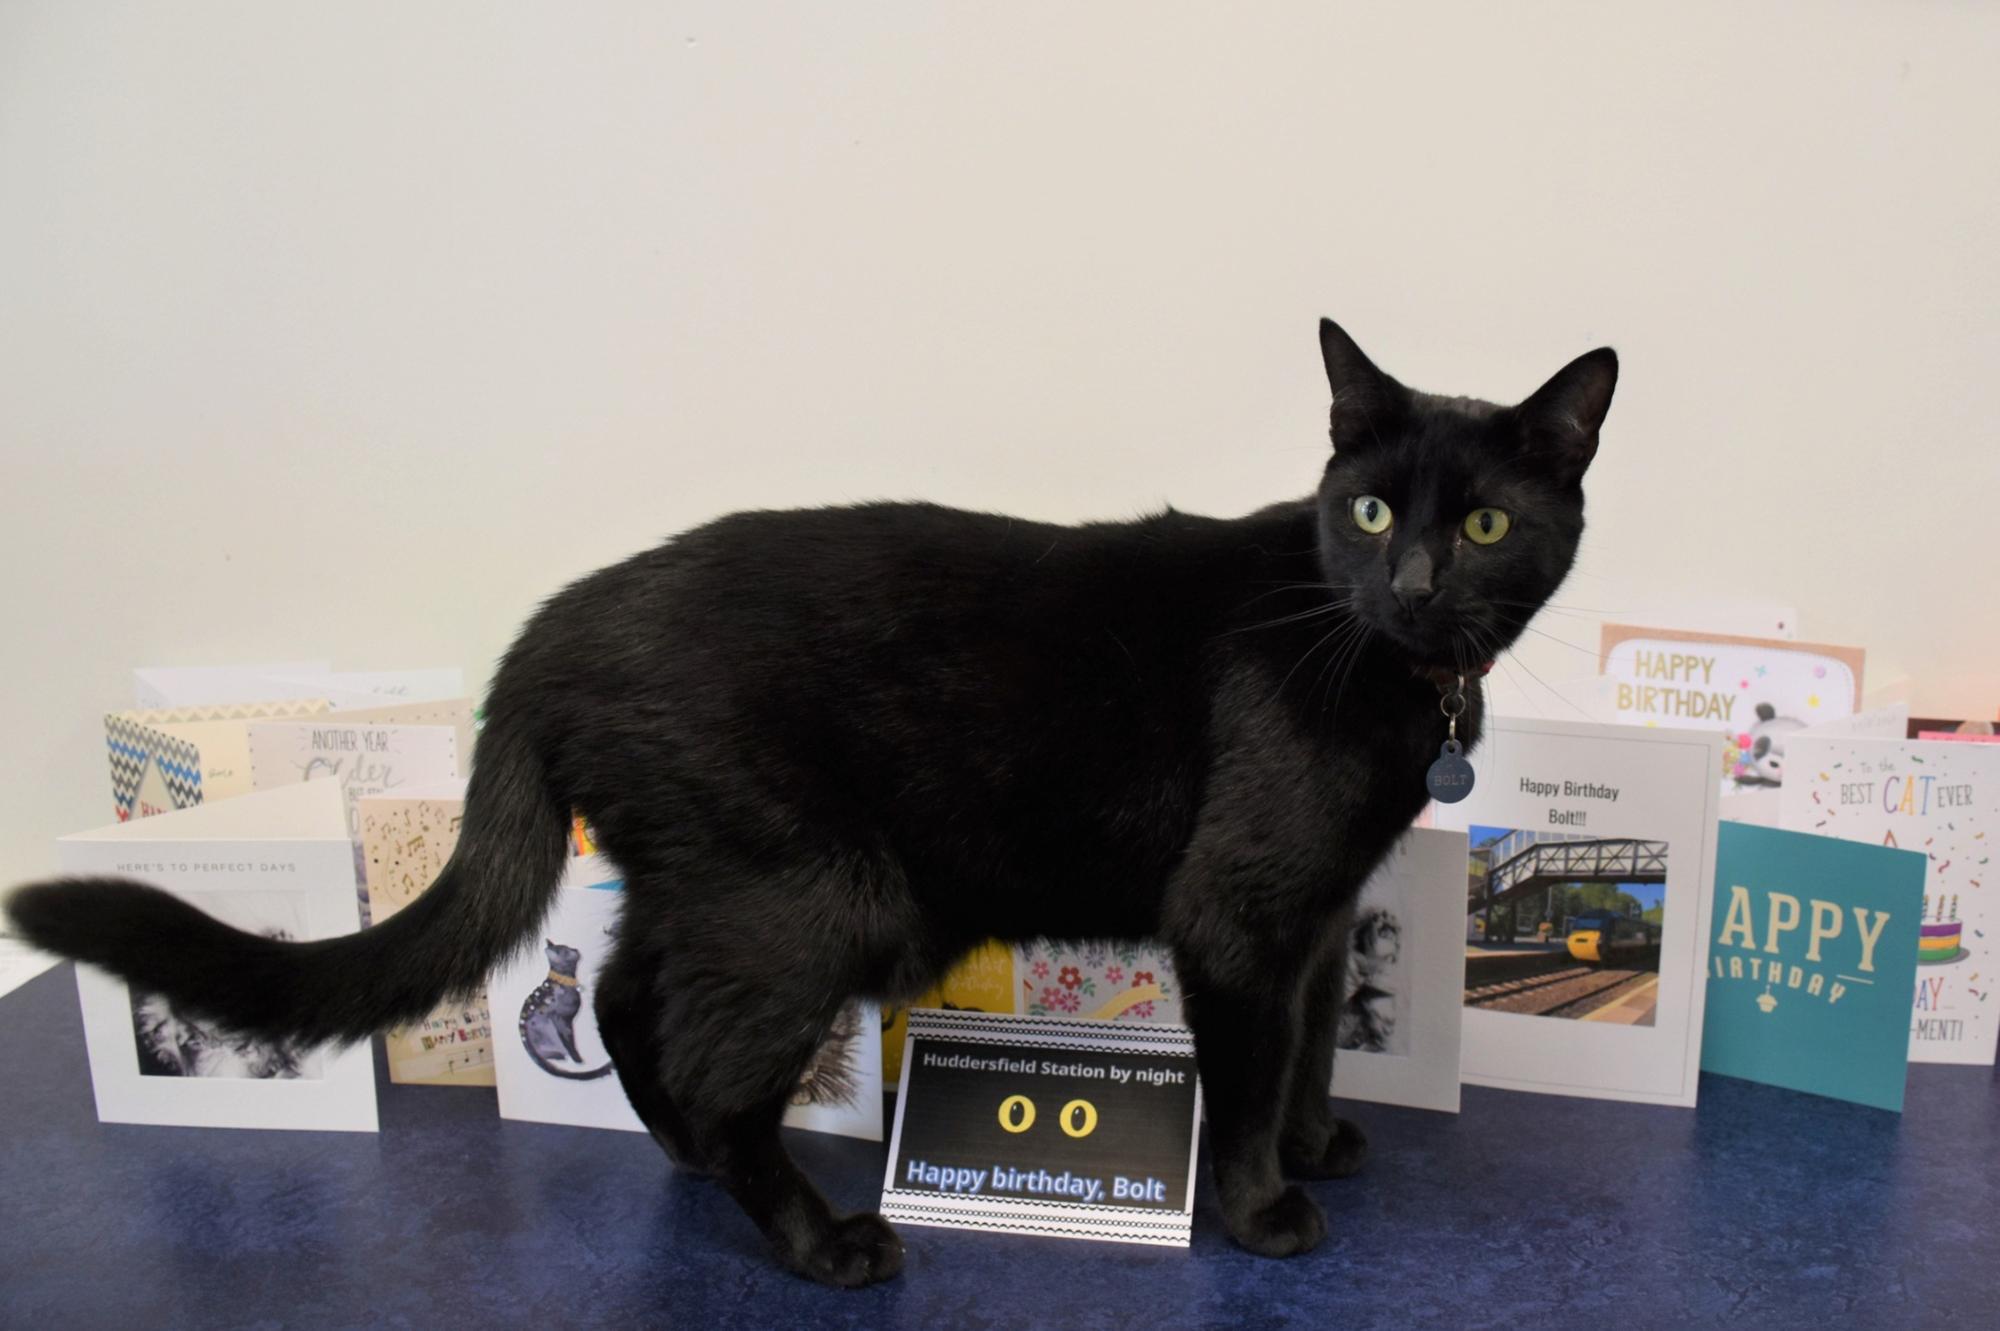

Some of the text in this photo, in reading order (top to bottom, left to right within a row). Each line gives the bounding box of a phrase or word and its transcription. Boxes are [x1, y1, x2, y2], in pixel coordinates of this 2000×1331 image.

[1635, 649, 1715, 684] HAPPY
[1617, 682, 1736, 721] BIRTHDAY
[312, 729, 389, 752] ANOTHER YEAR
[1434, 774, 1467, 786] BOLT
[1519, 777, 1620, 802] Happy Birthday
[1840, 775, 1973, 816] BEST CAT EVER
[1548, 808, 1587, 827] Bolt!!!
[117, 863, 296, 873] HERE'S TO PERFECT DAYS
[1717, 885, 1891, 972] APPY
[1705, 955, 1847, 1004] IRTHDAY
[923, 1052, 1185, 1086] Huddersfield Station by night
[907, 1160, 1167, 1202] Happy birthday, Bolt
